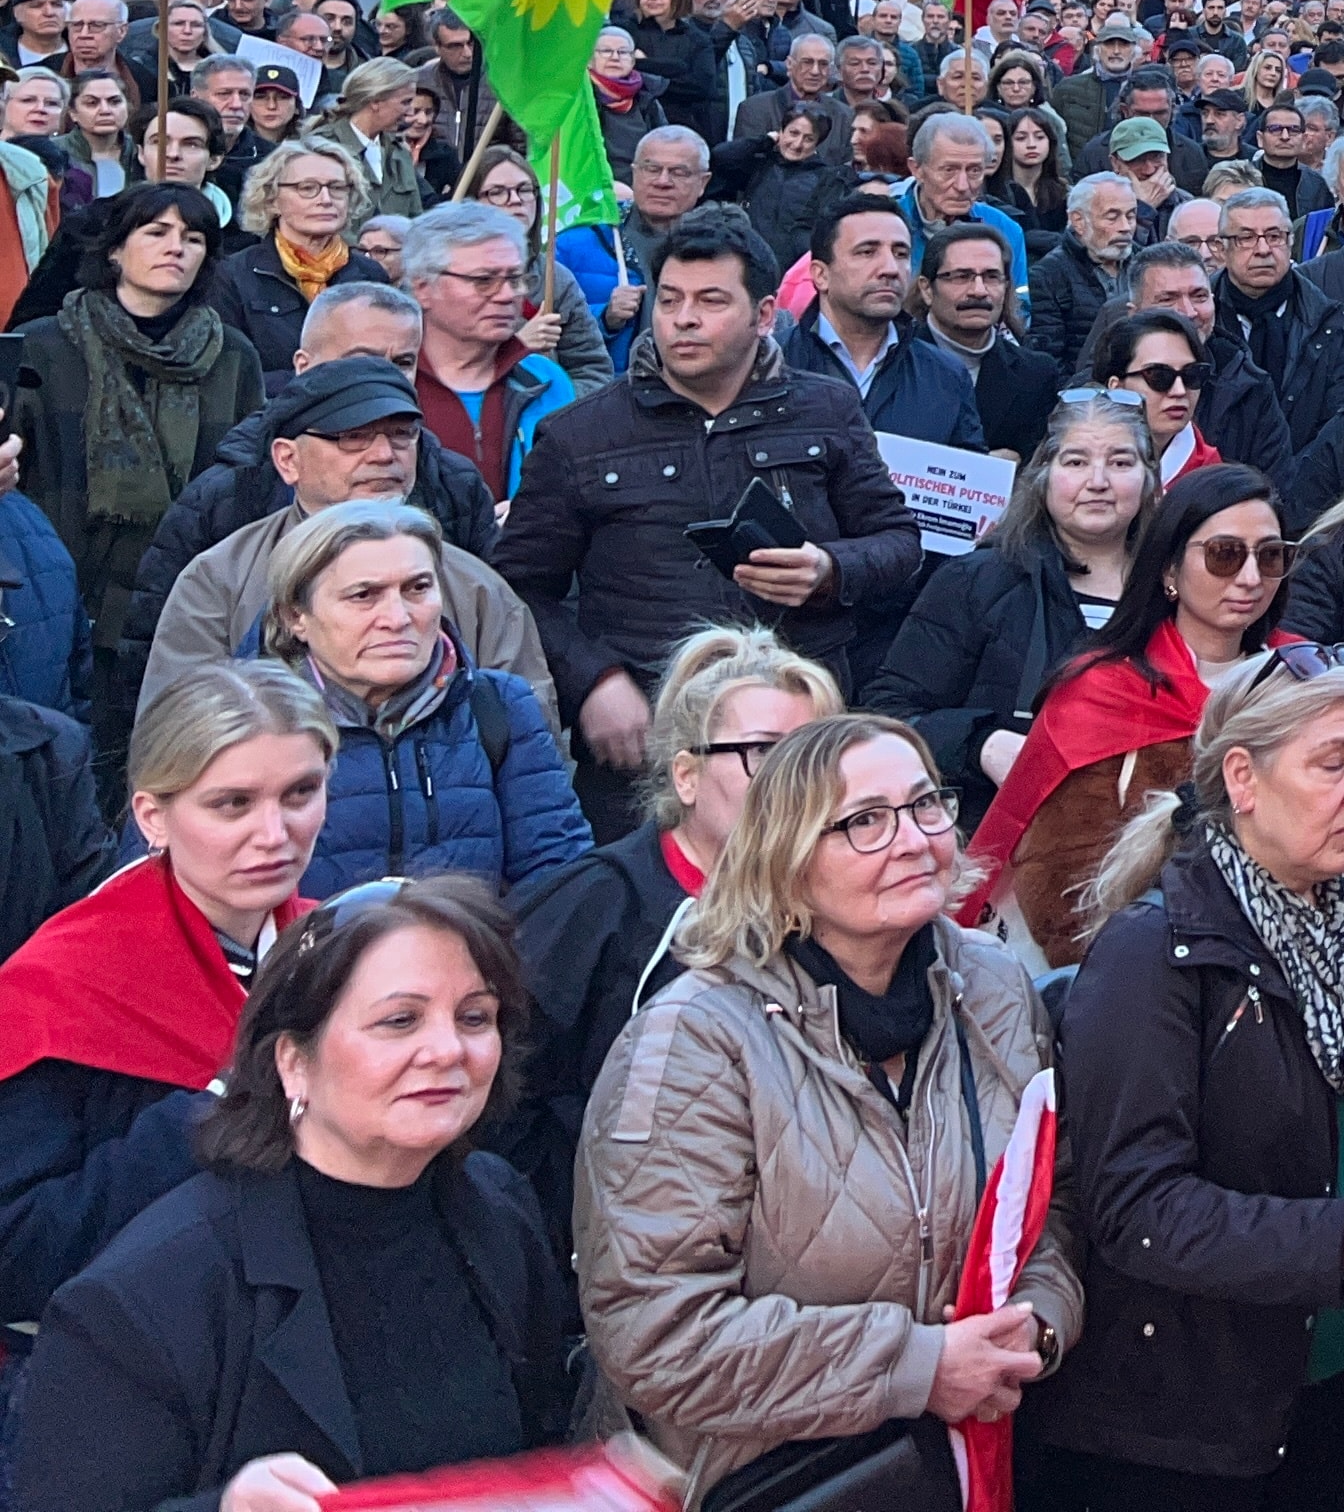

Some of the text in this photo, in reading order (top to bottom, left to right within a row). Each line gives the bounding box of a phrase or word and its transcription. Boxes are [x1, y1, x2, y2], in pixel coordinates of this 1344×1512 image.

[926, 465, 967, 481] NEIN ZUM
[888, 472, 957, 497] OLITISCHEN
[922, 495, 939, 506] DER
